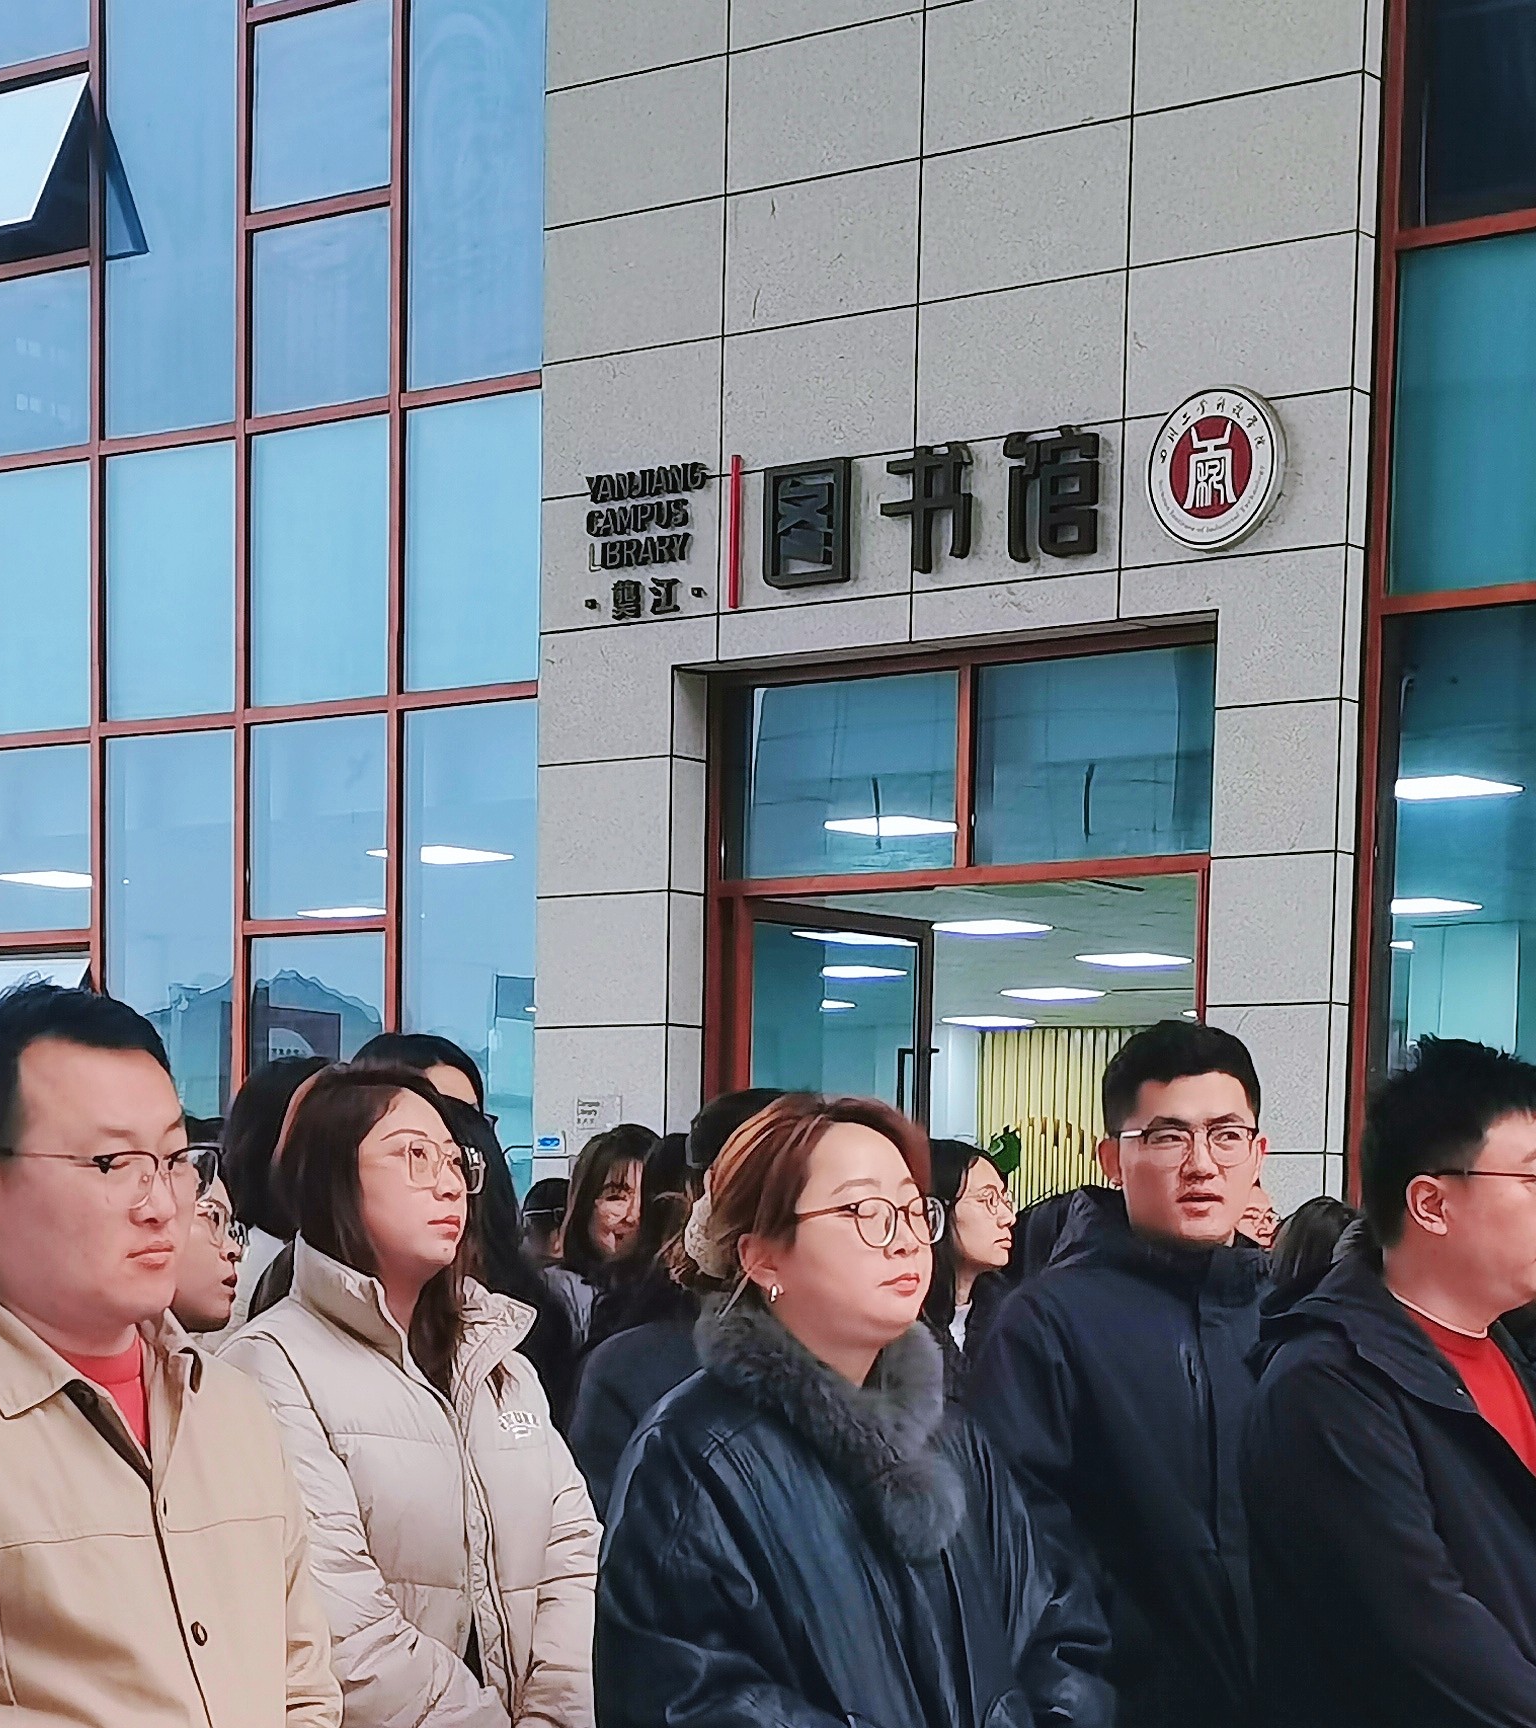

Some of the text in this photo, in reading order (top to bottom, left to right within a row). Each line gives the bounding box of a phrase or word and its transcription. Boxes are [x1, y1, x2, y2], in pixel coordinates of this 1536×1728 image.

[585, 462, 707, 504] YANJIANG
[586, 499, 690, 537] CAMPUS
[763, 425, 1099, 590] 图书馆
[589, 533, 693, 572] LIBRARY
